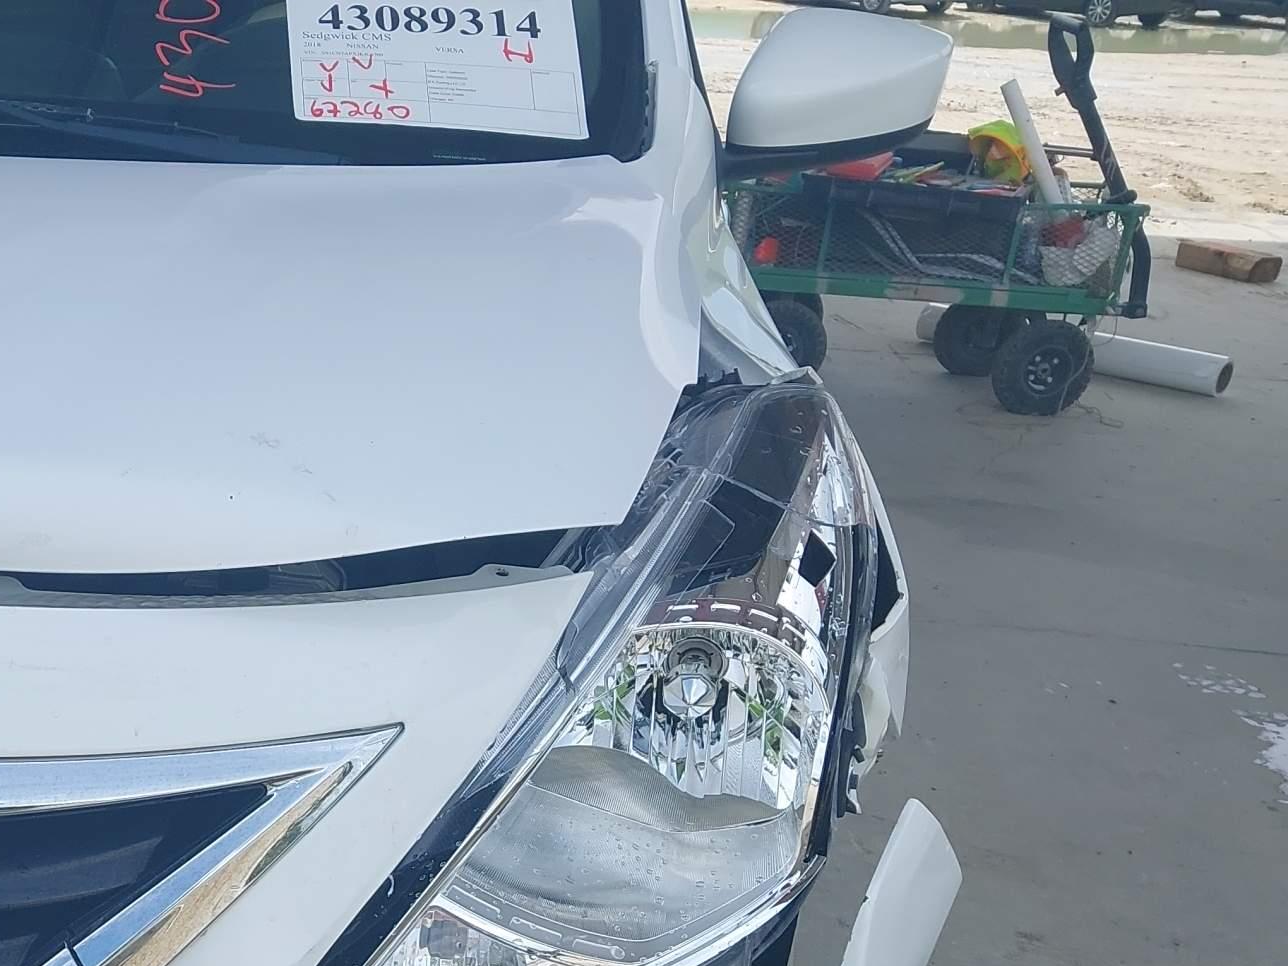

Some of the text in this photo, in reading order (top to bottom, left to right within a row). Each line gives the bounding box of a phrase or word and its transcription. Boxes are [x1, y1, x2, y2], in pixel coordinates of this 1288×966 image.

[318, 4, 541, 39] 43089314
[302, 31, 392, 41] Sedgwick CMS
[346, 42, 379, 50] NISSAN
[435, 46, 464, 54] VERSA
